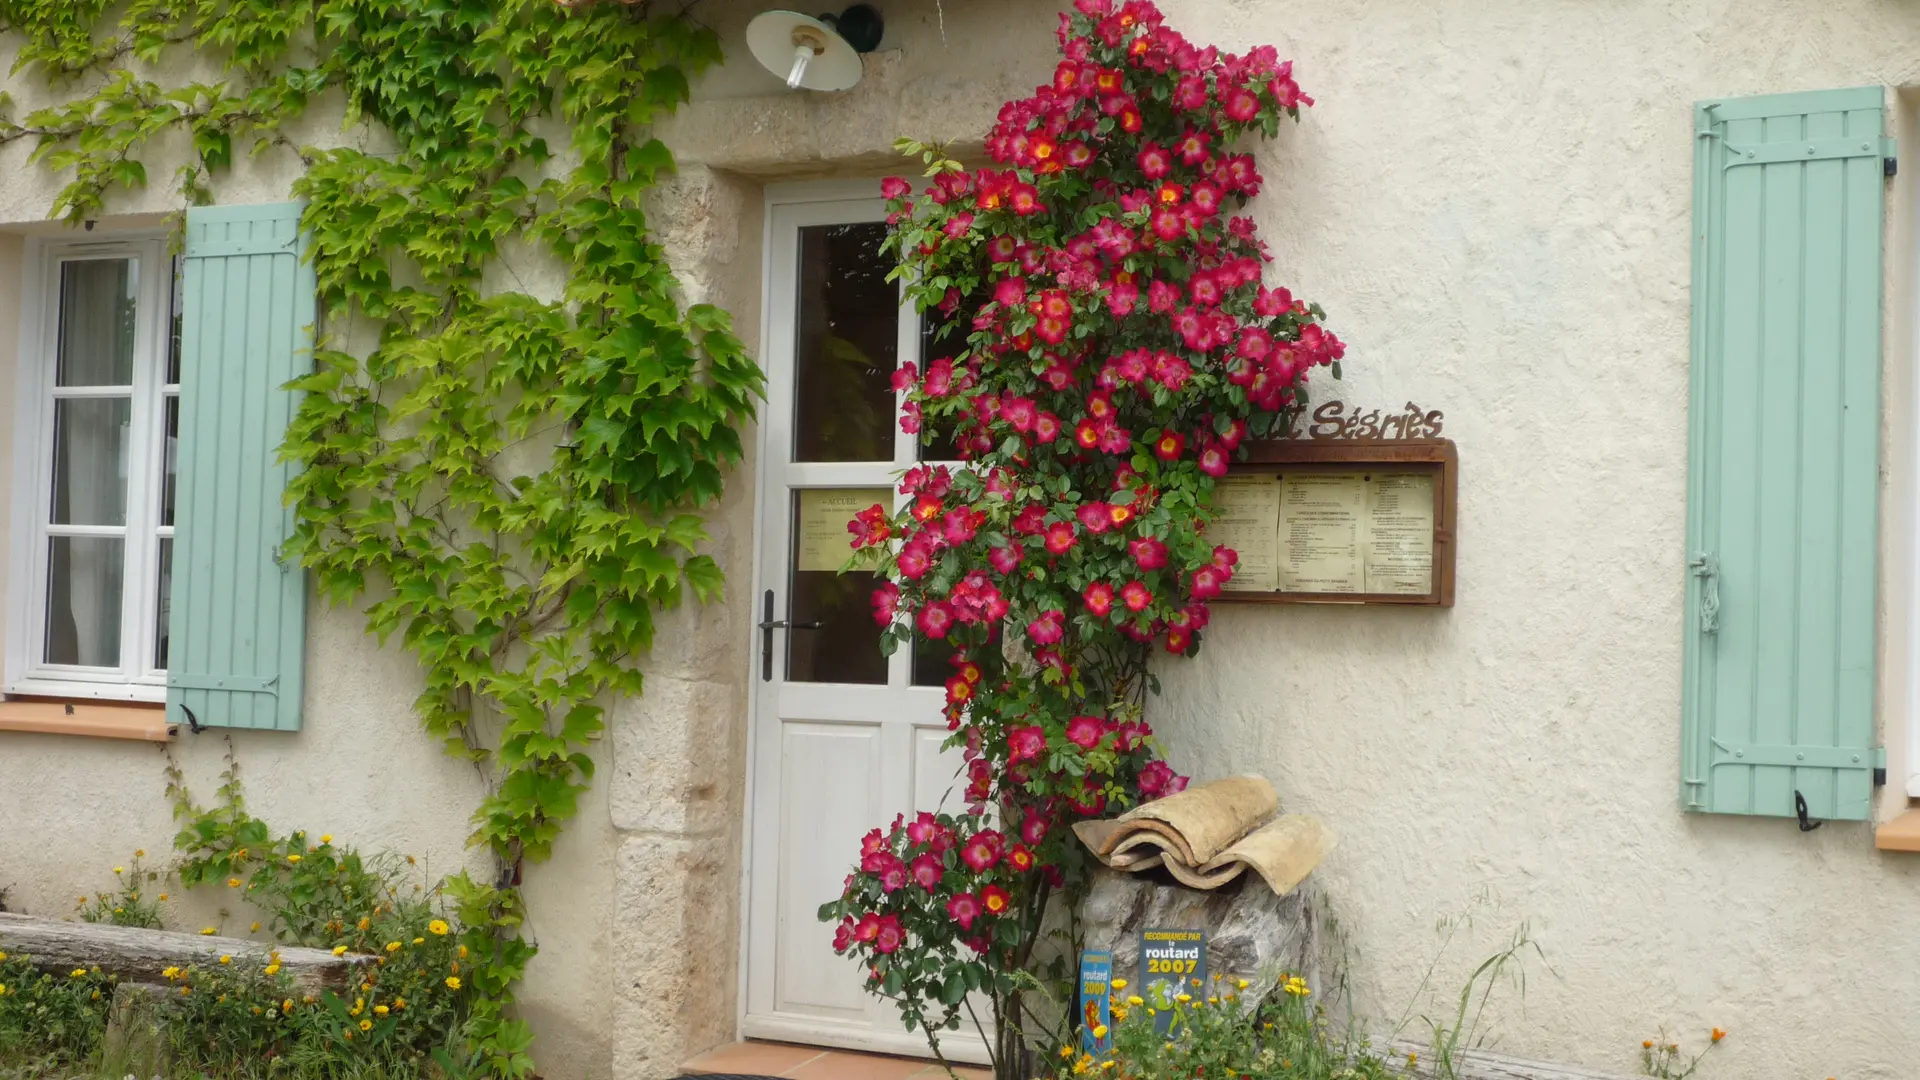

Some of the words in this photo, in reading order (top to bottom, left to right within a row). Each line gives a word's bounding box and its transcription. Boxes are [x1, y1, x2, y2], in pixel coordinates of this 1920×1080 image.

[1309, 400, 1444, 440] Ségriès
[1188, 932, 1201, 941] PAR
[1146, 947, 1199, 959] routard
[1147, 959, 1198, 974] 2007
[1083, 970, 1108, 981] routard
